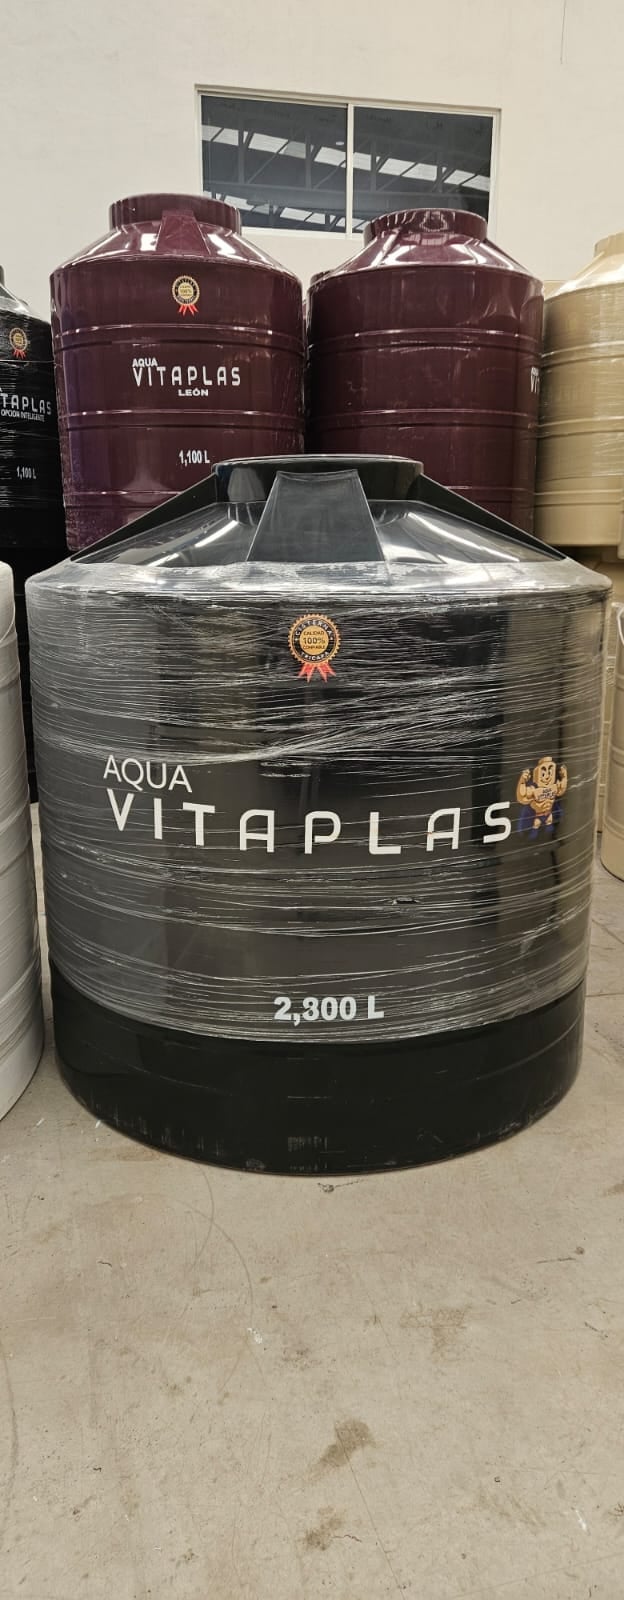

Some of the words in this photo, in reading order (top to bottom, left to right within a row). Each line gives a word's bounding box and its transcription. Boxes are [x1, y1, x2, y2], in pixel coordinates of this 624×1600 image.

[132, 357, 158, 367] AQUA
[132, 365, 241, 387] VITAPLAS
[178, 388, 209, 397] LEÓN
[179, 449, 203, 467] 1,100
[203, 449, 210, 464] L
[16, 466, 32, 480] 1,100
[32, 468, 37, 480] L
[296, 619, 332, 636] CISTERNA
[303, 637, 326, 645] 100%
[103, 754, 193, 793] AQUA
[106, 787, 512, 855] VITAPLAS
[367, 995, 385, 1019] L
